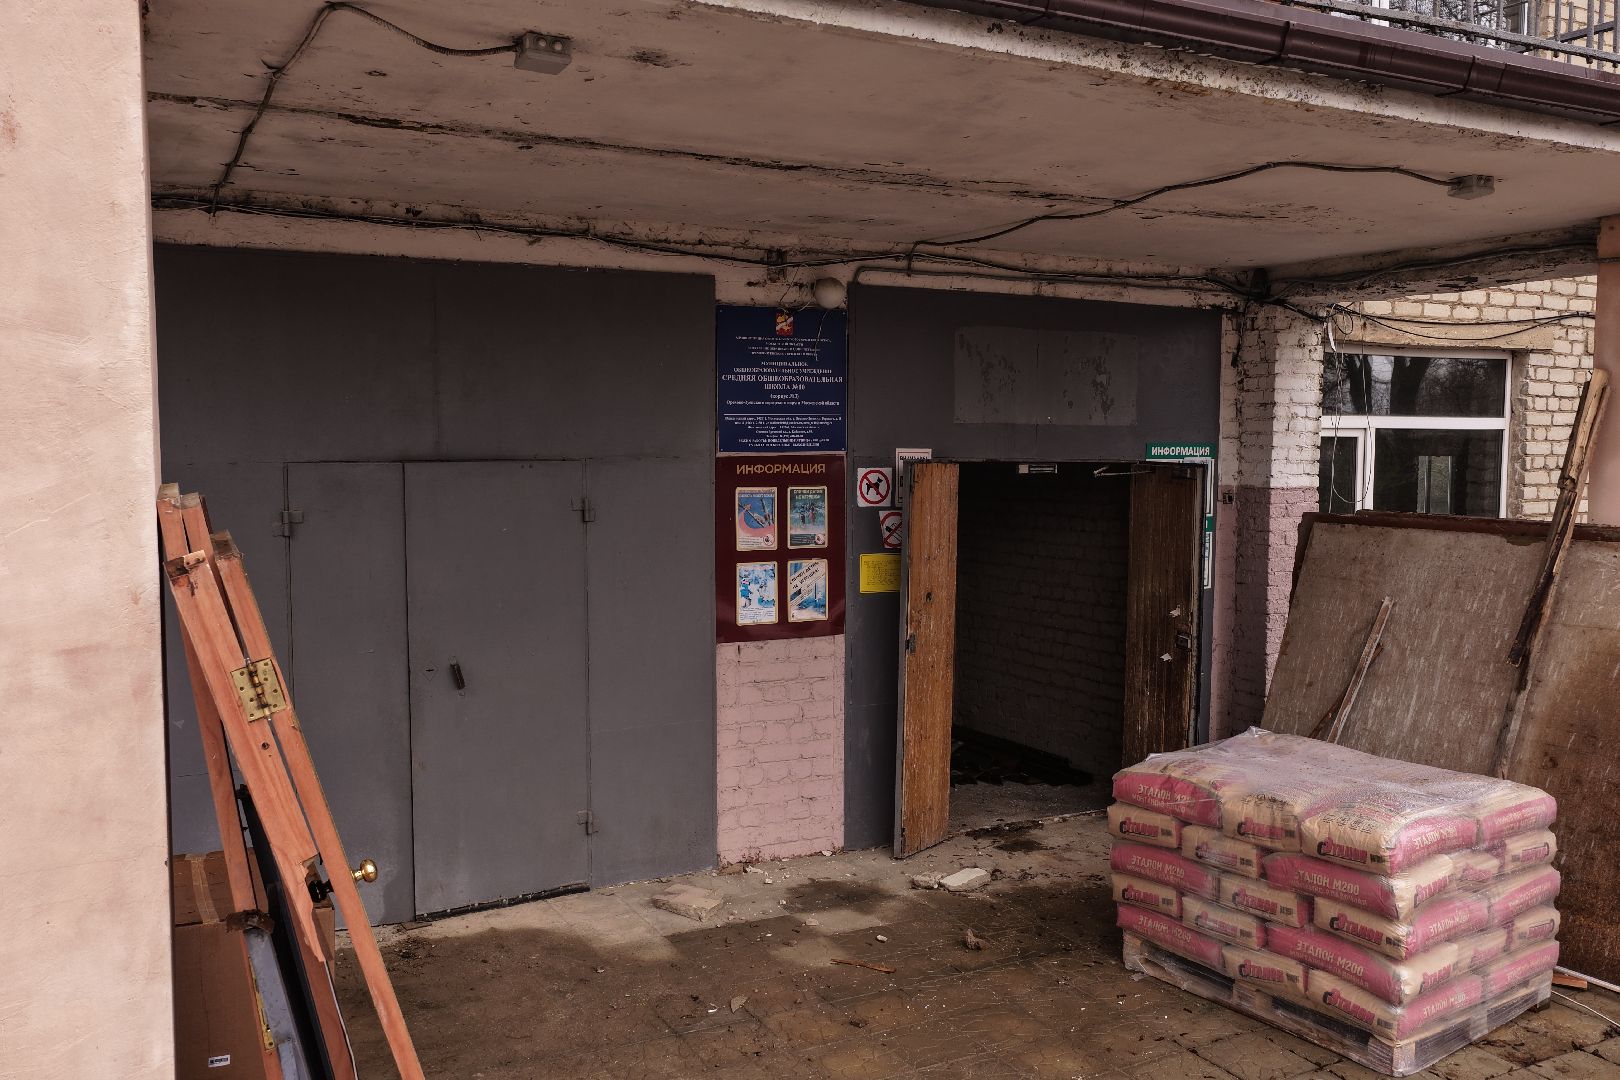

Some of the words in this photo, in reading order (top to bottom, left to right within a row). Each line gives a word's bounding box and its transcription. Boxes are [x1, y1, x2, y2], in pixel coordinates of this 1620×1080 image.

[721, 374, 756, 382] СРЕДНЯЯ
[757, 374, 843, 383] ОБЩЕОБРАЗОВАТЕЛЬНАЯ
[1152, 446, 1210, 457] ИНФОРМАЦИЯ
[736, 463, 826, 475] ИНФОРМАЦИЯ
[1138, 783, 1172, 801] ЭТАЛОН
[1130, 854, 1163, 872] ЭТАЛОН
[1295, 870, 1330, 887] ЭТАЛОН
[1332, 879, 1360, 896] М200
[1138, 914, 1169, 933] ЭТАЛОН
[1296, 939, 1335, 963] ЭТАЛОН
[1336, 955, 1365, 977] М200
